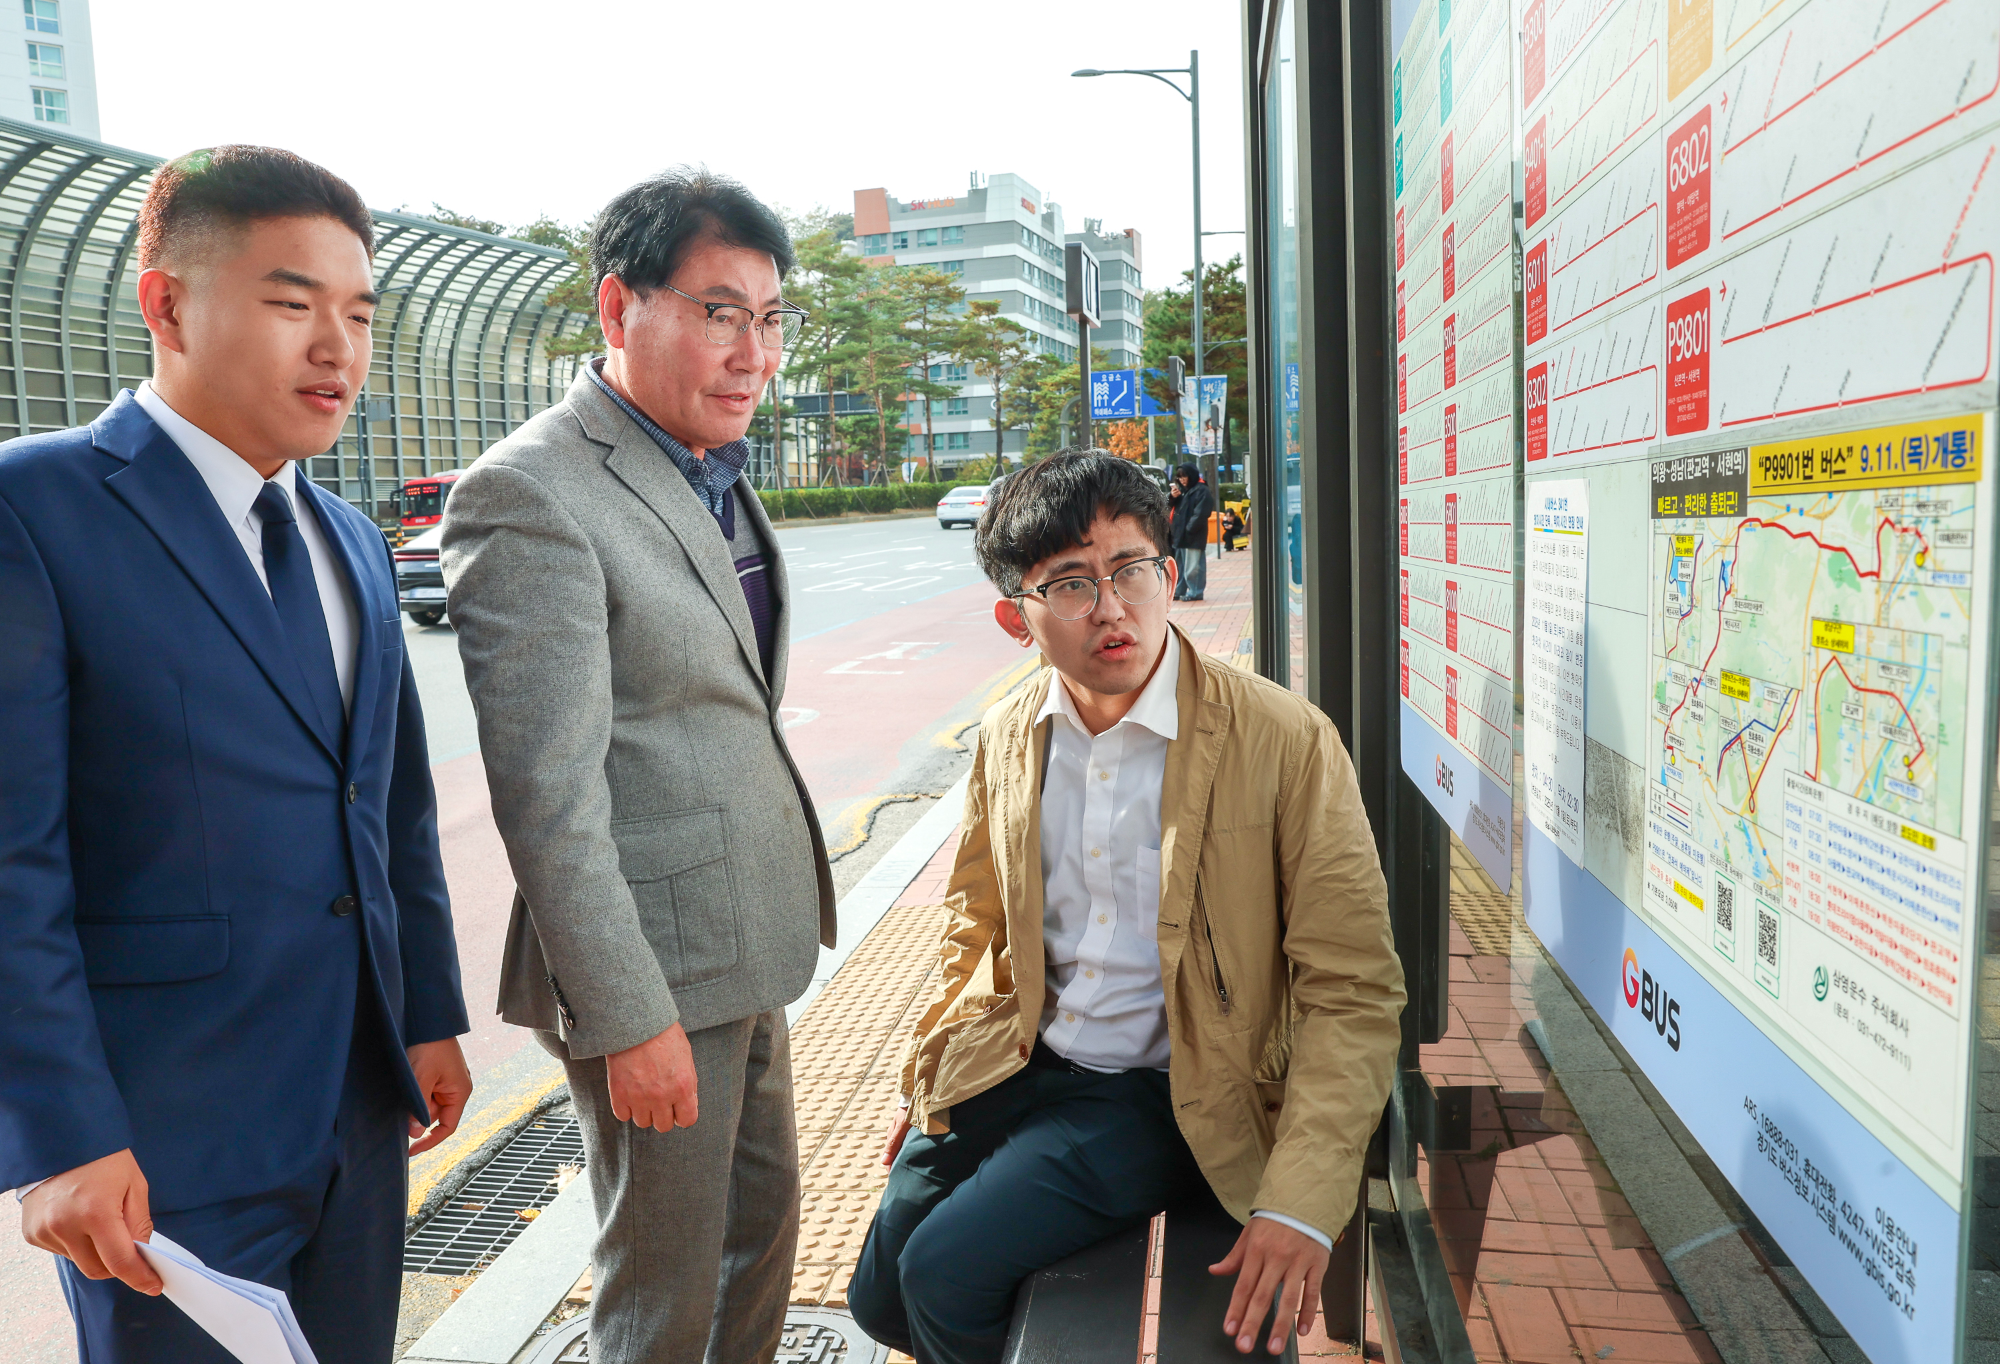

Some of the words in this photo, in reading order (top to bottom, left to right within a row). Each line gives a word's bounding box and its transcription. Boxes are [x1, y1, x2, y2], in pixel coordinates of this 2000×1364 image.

[1524, 2, 1544, 56] 9300
[1441, 53, 1450, 85] 521
[1525, 127, 1546, 178] 9401-1
[1669, 124, 1709, 193] 6802
[911, 200, 926, 211] SK
[928, 196, 955, 209] HUB
[1527, 251, 1546, 293] 6011
[1668, 307, 1708, 364] P9801
[1101, 374, 1121, 382] 요금소
[1527, 373, 1546, 410] 8302
[1094, 408, 1113, 416] 하이패스
[1652, 455, 1710, 483] 의왕~성남(판교역
[1717, 449, 1746, 477] 서현역)
[1758, 449, 1815, 482] “P9901번
[1820, 446, 1854, 478] 버스”
[1657, 496, 1678, 517] 빠르고
[1684, 492, 1707, 515] 편리한
[1710, 491, 1738, 515] 출퇴근!
[1436, 754, 1454, 797] GBUS
[1623, 947, 1680, 1052] GBUS
[1832, 970, 1867, 1006] 삼영운수
[1871, 995, 1909, 1038] 주식회사
[1834, 1002, 1849, 1023] (문의
[1857, 1020, 1911, 1071] 031-472-9111)
[1744, 1095, 1759, 1125] ARS.
[1840, 1200, 1916, 1296] 4247+WEB접속
[1757, 1131, 1778, 1167] 경기도
[1779, 1155, 1810, 1203] 버스정보
[1811, 1196, 1837, 1236] 시스템
[1838, 1225, 1915, 1321] www.gbis.go.kr
[1875, 1207, 1918, 1267] 이용안내
